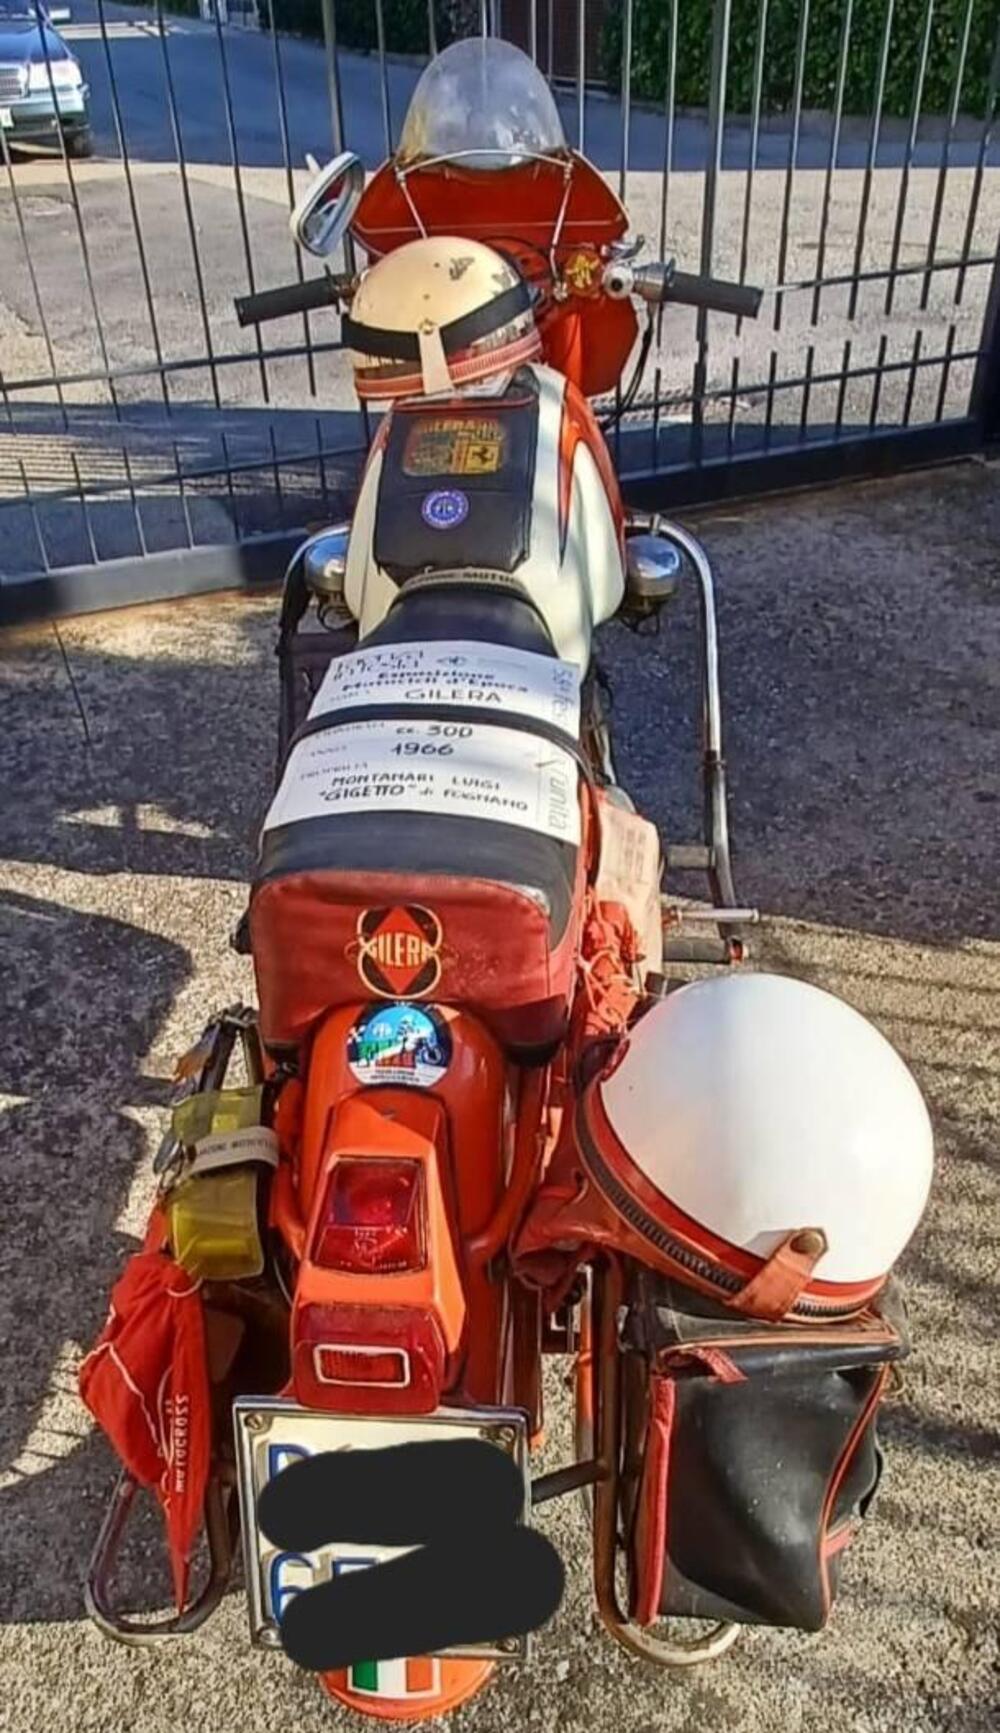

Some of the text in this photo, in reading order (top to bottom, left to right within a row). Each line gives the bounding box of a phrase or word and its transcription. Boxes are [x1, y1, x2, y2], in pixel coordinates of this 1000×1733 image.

[405, 688, 502, 704] GILERA
[390, 742, 455, 757] 1966
[331, 772, 502, 791] MONTANARI LUIGI
[366, 932, 434, 966] GILERA
